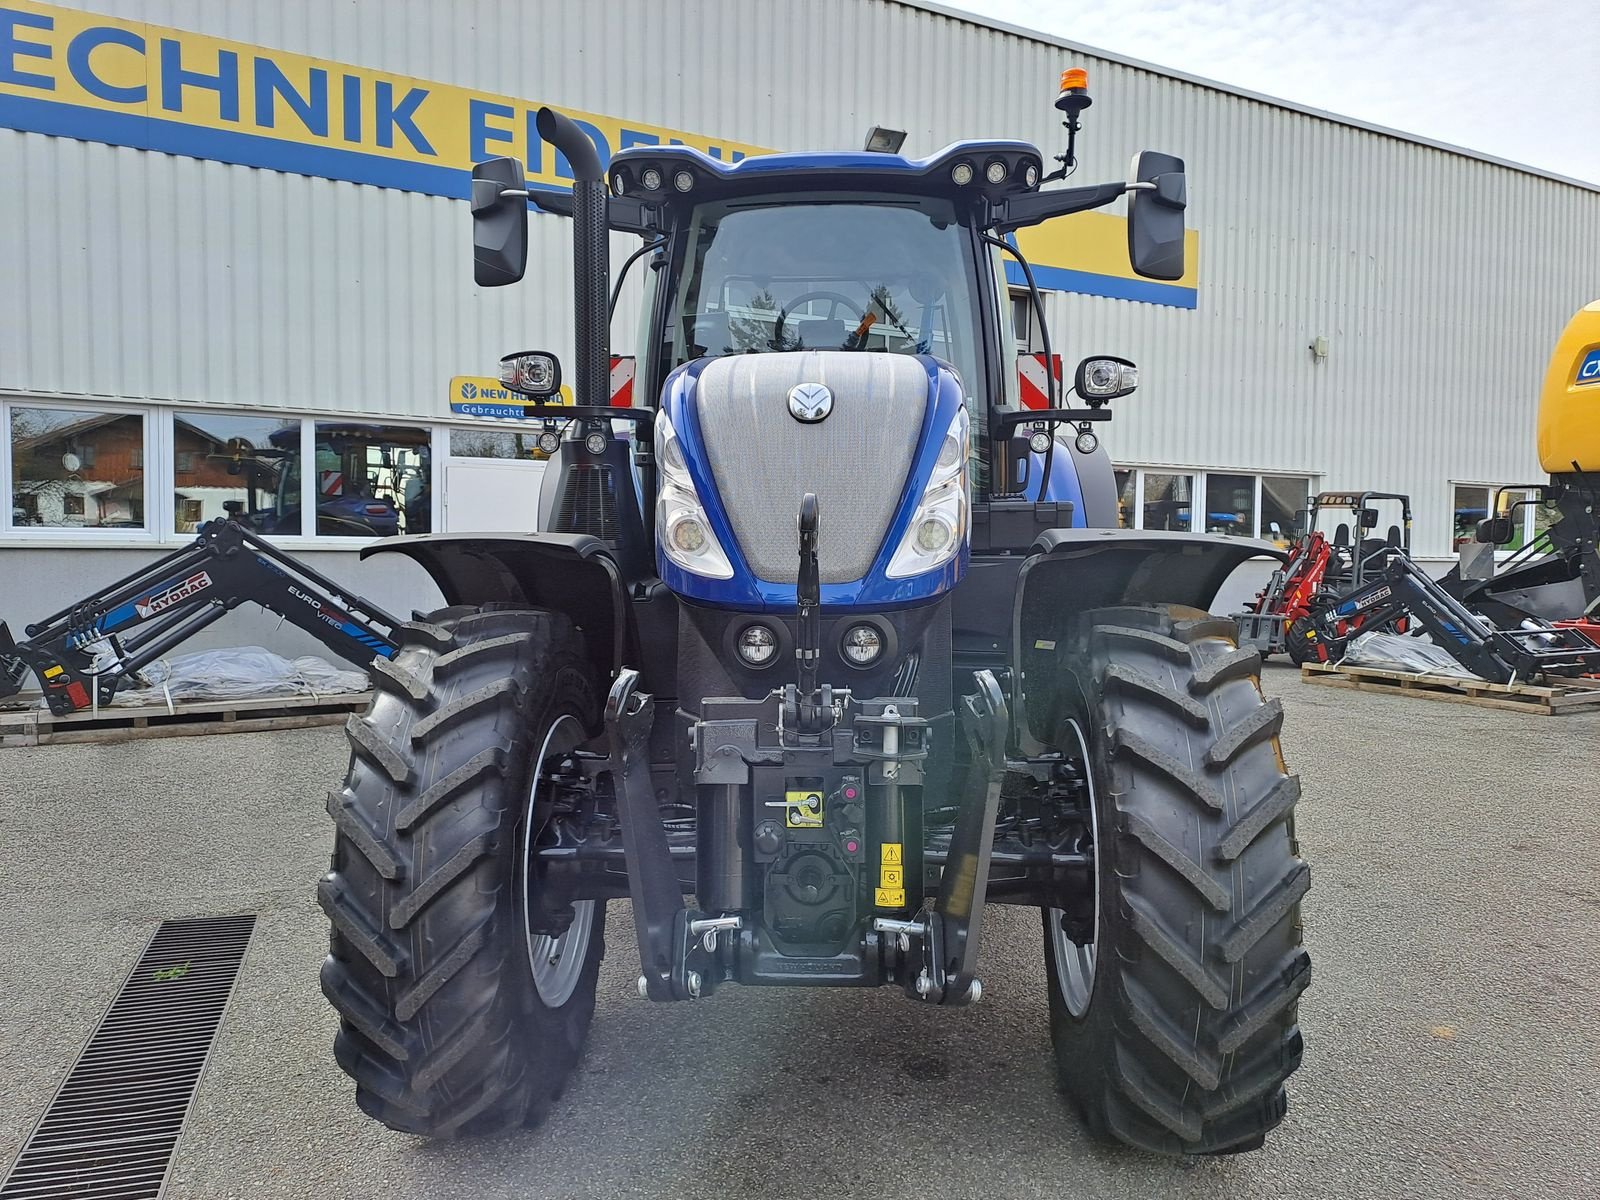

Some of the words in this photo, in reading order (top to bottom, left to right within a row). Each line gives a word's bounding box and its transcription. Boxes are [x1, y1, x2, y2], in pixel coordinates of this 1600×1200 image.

[0, 8, 437, 157] ECHNIK
[480, 388, 508, 400] NEW
[461, 404, 525, 417] Gebrauchtt
[151, 579, 209, 612] HYDRAC
[287, 585, 322, 609] EURO
